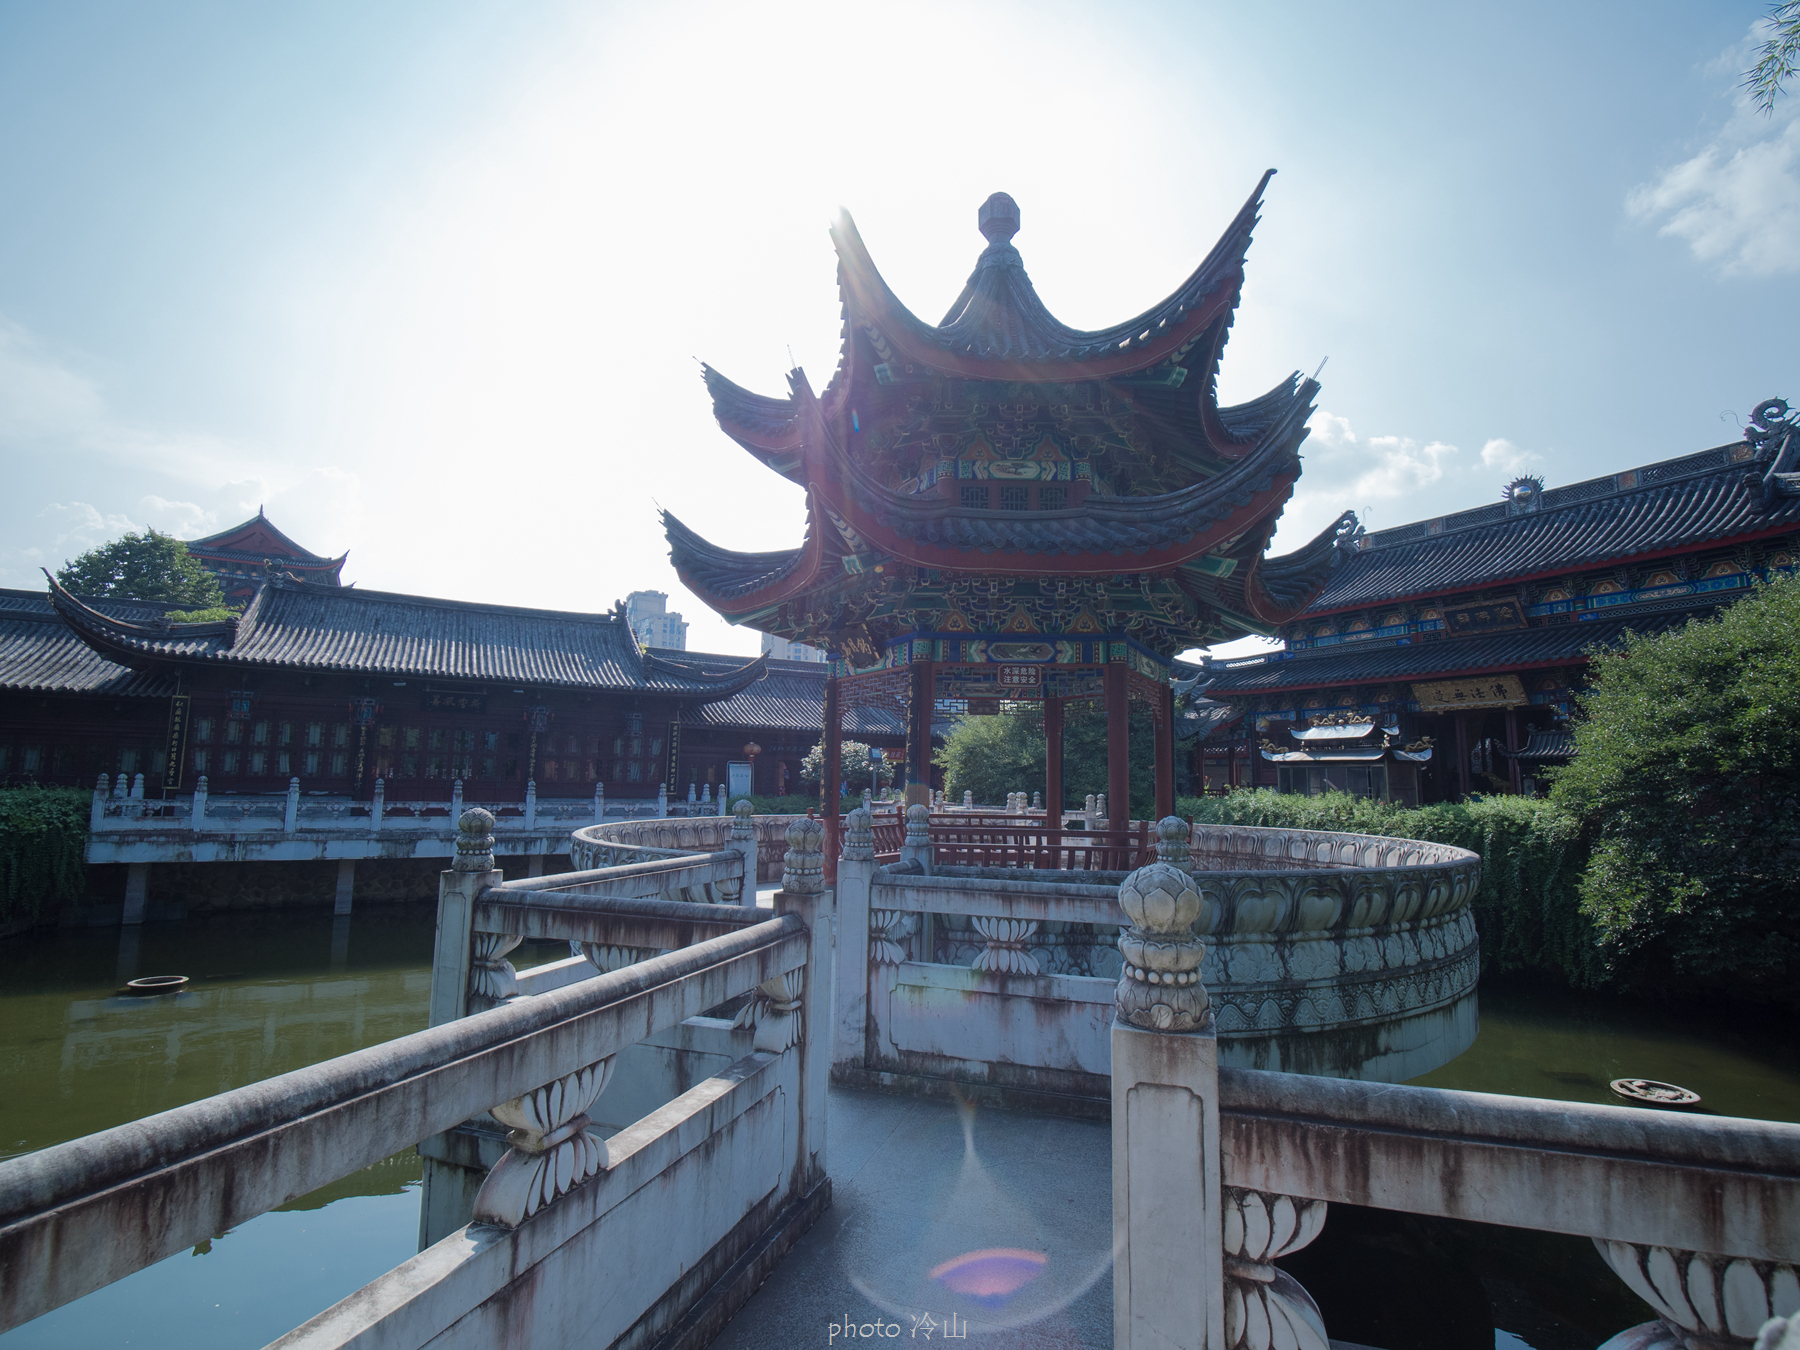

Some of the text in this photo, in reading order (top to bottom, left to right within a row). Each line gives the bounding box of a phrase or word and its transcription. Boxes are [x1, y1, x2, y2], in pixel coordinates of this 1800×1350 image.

[1003, 666, 1036, 675] 水深危险
[1003, 676, 1036, 684] 注意安全
